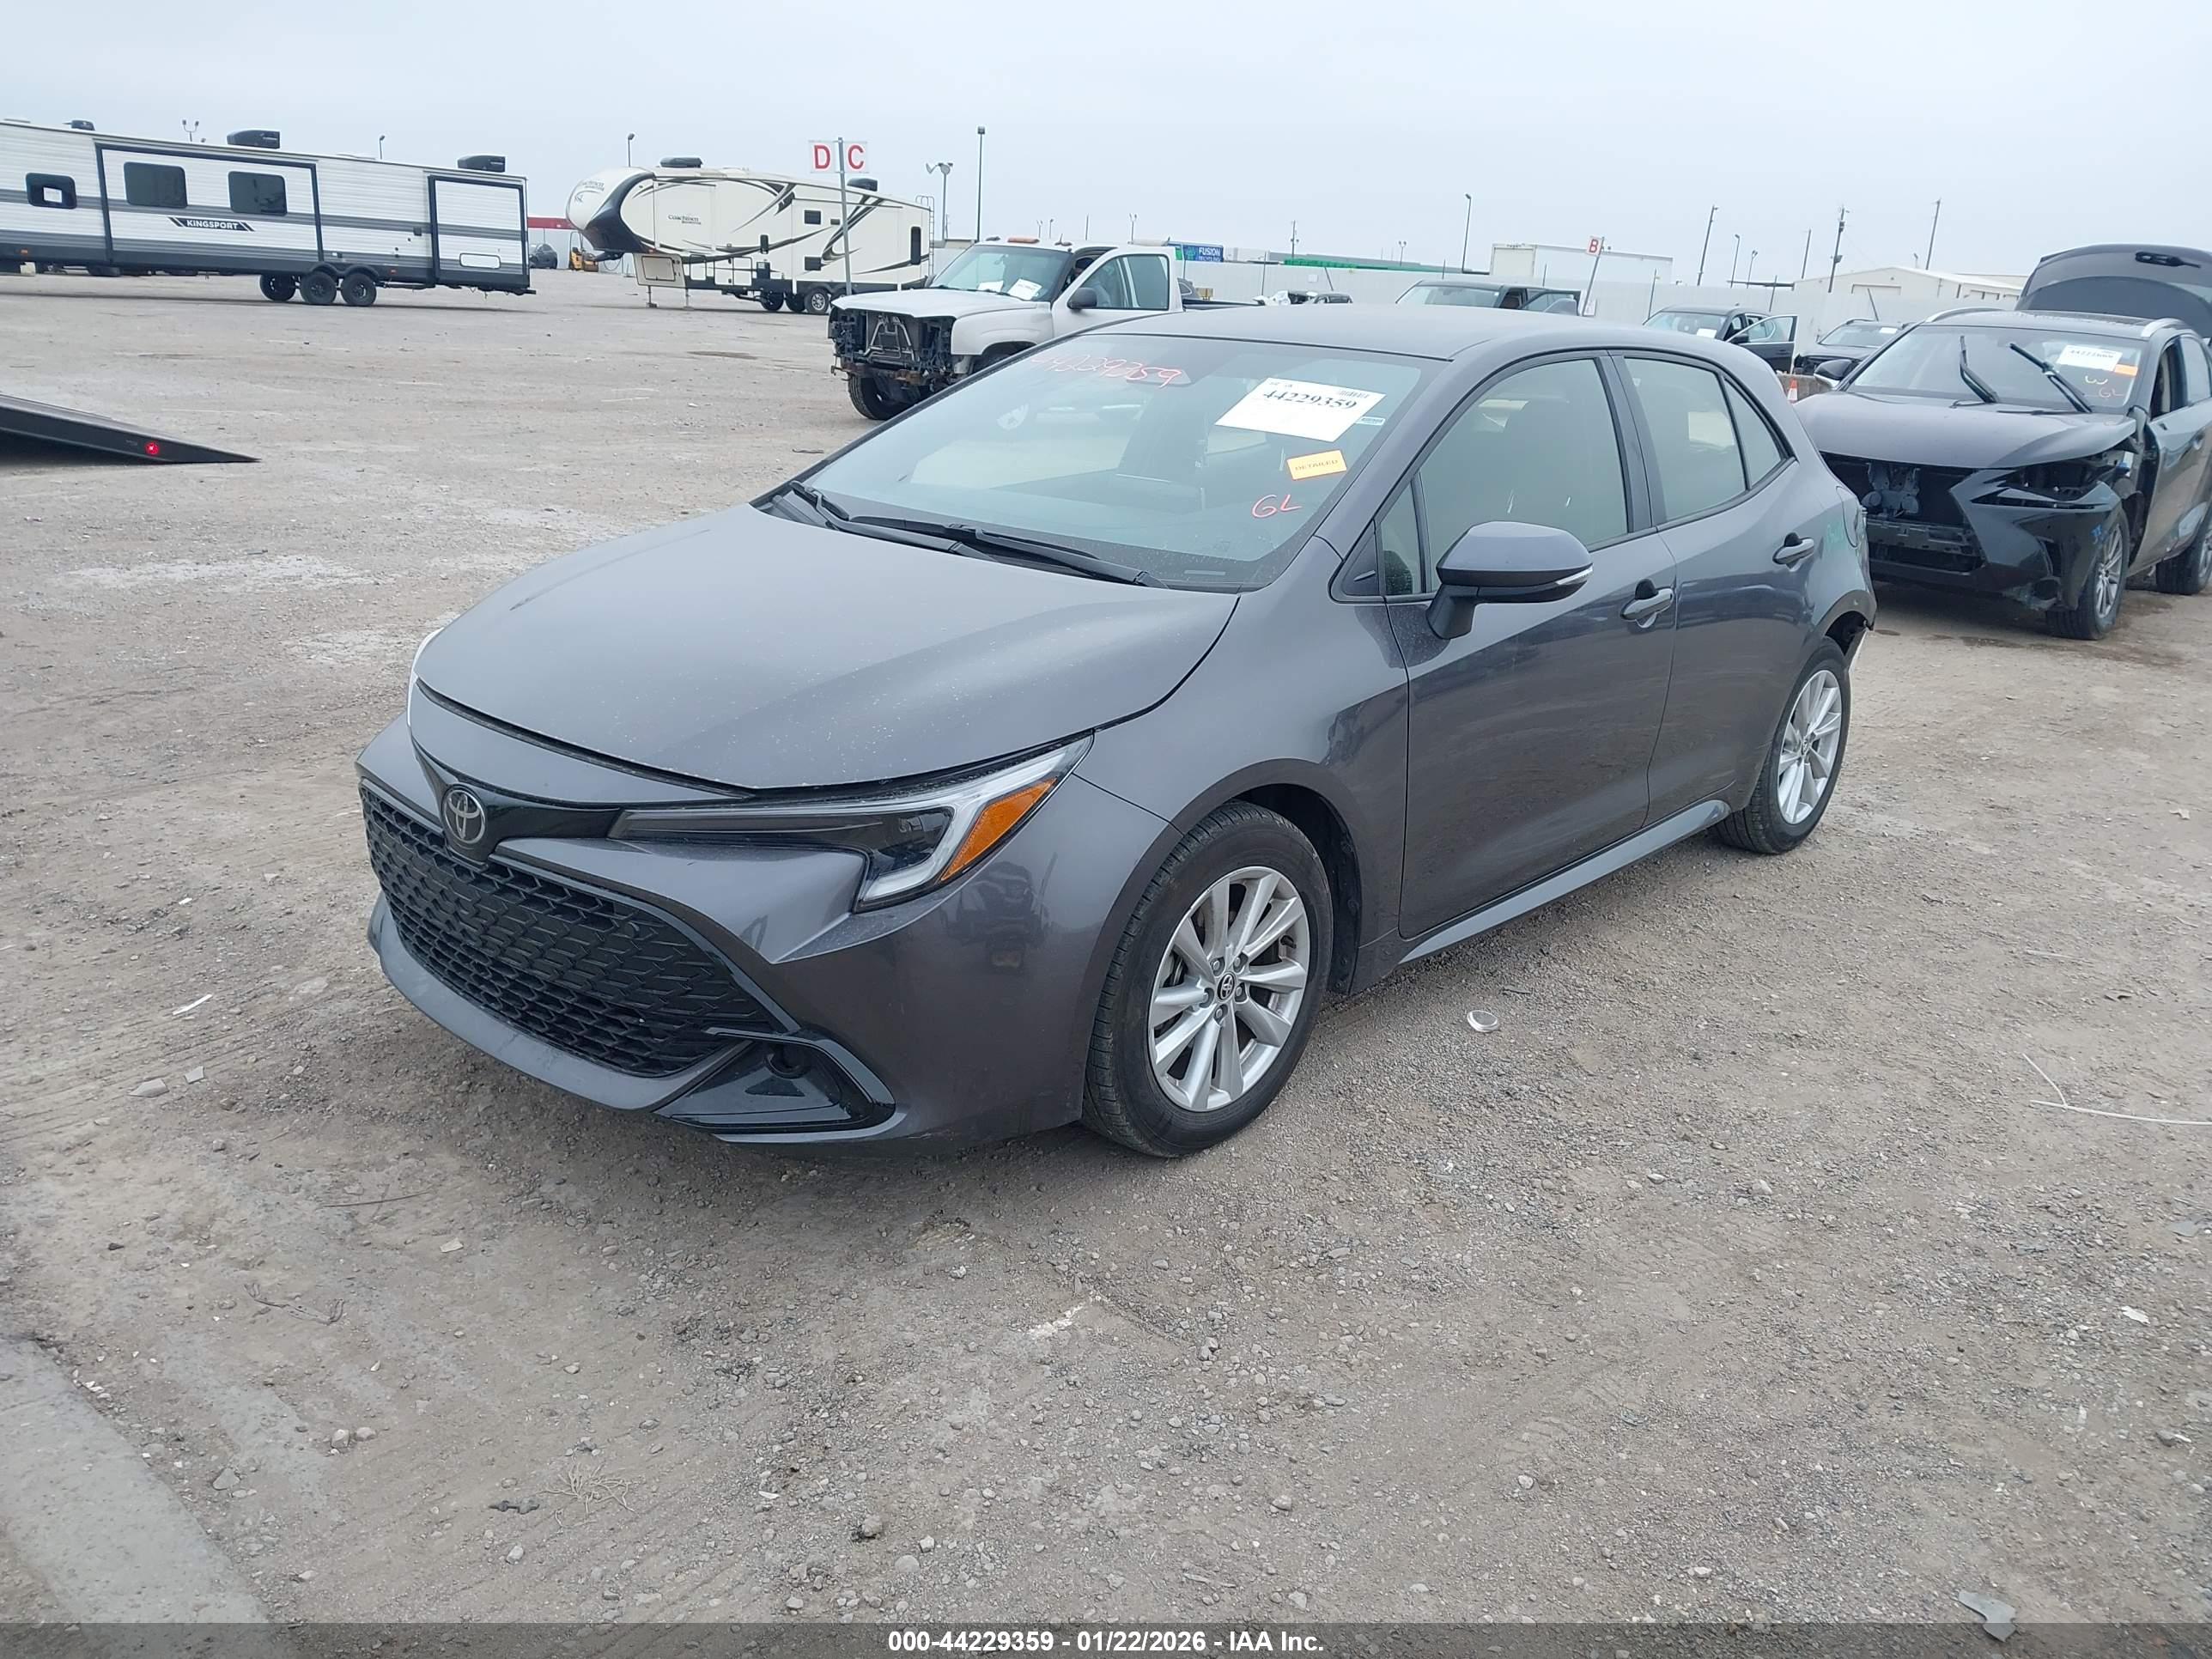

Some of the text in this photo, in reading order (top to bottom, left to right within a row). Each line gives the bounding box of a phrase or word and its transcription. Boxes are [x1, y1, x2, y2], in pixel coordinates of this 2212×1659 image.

[814, 144, 830, 169] D
[848, 144, 864, 170] C
[186, 219, 239, 230] KINGSPORT
[1198, 246, 1221, 257] FUSION
[1589, 239, 1599, 253] B
[1263, 389, 1358, 410] 44229359
[1251, 494, 1304, 520] GL
